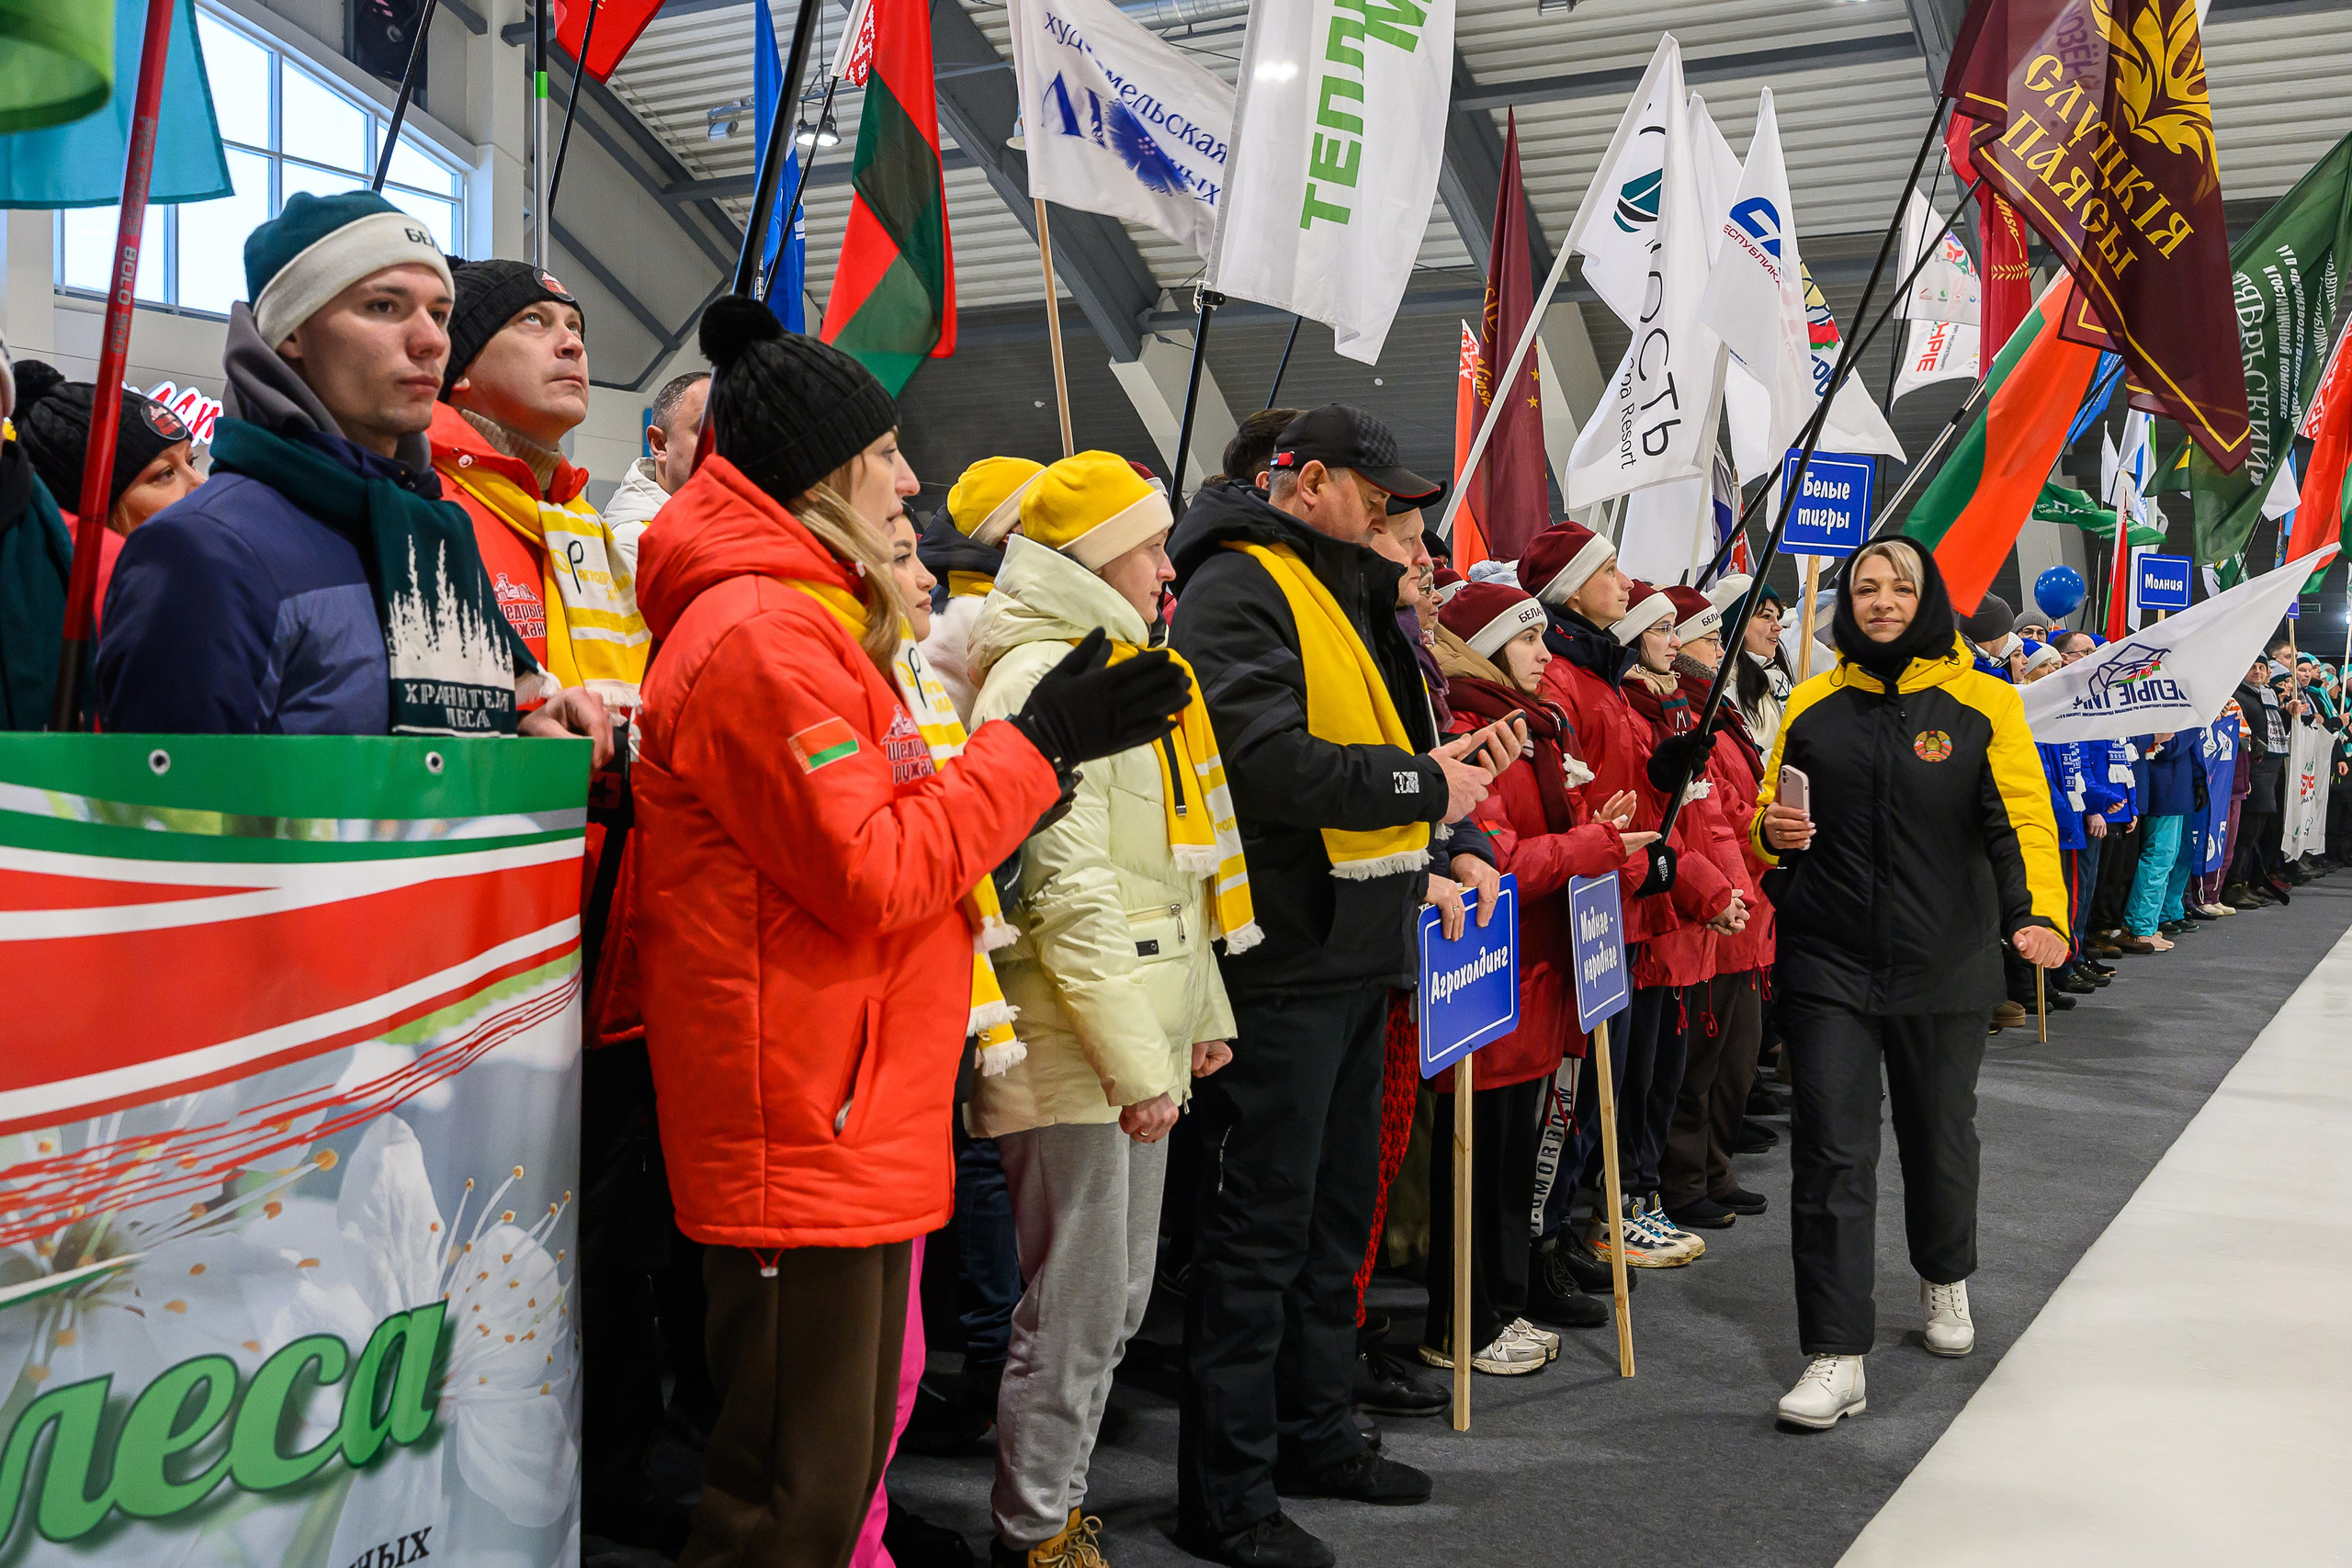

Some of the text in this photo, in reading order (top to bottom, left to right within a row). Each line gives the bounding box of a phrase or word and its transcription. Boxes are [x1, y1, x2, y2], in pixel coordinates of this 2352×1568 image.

[117, 244, 138, 306] BOLO
[110, 311, 130, 355] 500
[2278, 356, 2290, 420] КОМПЛЕКС
[1621, 401, 1637, 469] Resort
[1803, 470, 1850, 501] Белые
[1797, 507, 1850, 536] тигры
[2144, 573, 2184, 592] Молния
[446, 706, 492, 728] ЛЕСА
[1579, 905, 1609, 945] Моднае
[1430, 945, 1509, 1005] Агрохолдинг
[1583, 940, 1618, 989] народнае
[0, 1299, 449, 1549] леса
